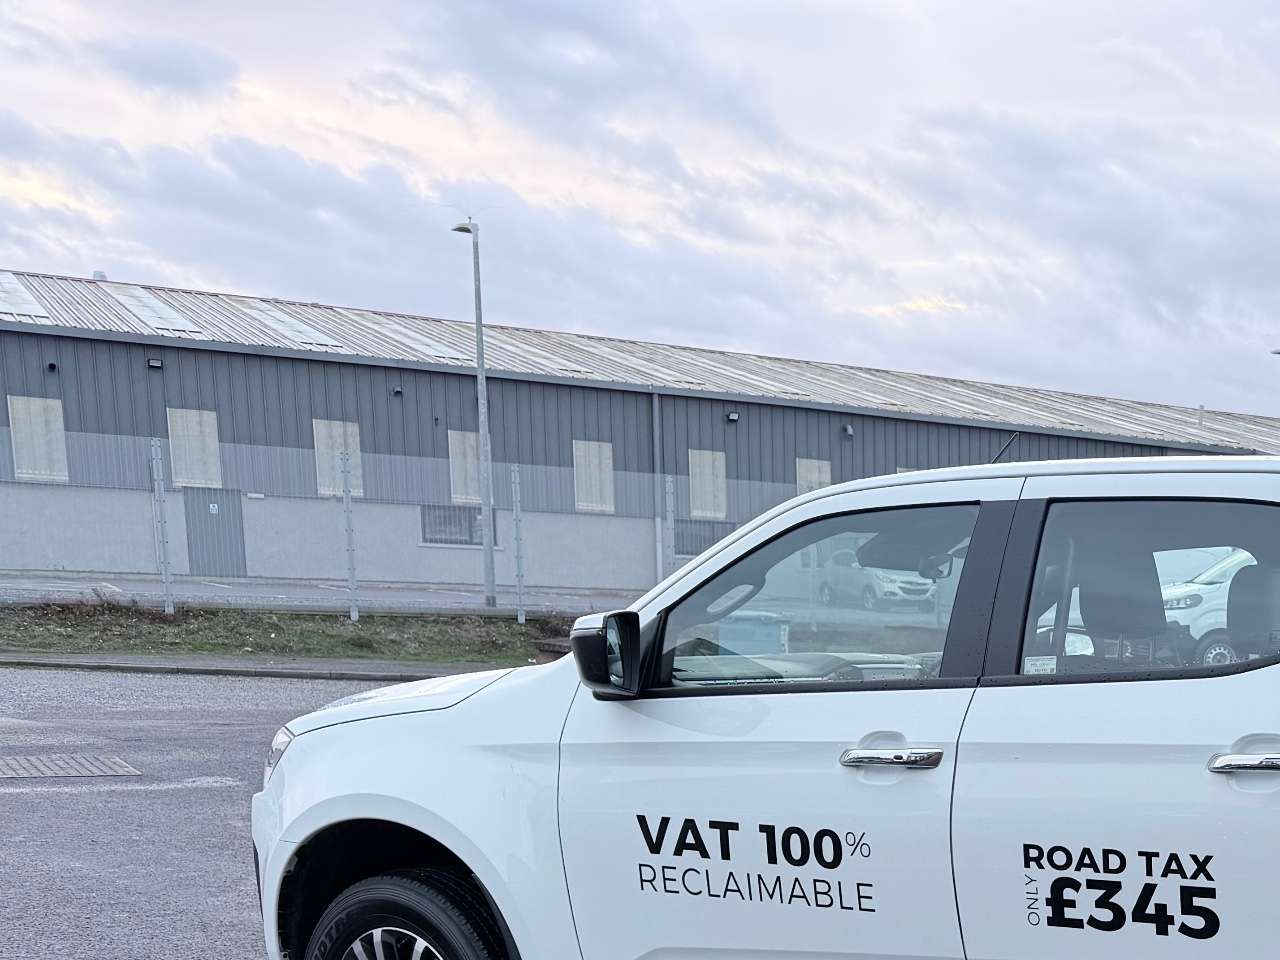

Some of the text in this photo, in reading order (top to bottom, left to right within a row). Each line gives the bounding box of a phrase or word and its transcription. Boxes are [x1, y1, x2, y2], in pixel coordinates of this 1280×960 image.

[636, 814, 871, 870] VAT 100%
[1022, 843, 1216, 882] ROAD TAX
[638, 862, 876, 913] RECLAIMABLE
[1024, 873, 1040, 927] ONLY
[1044, 876, 1221, 940] £345
